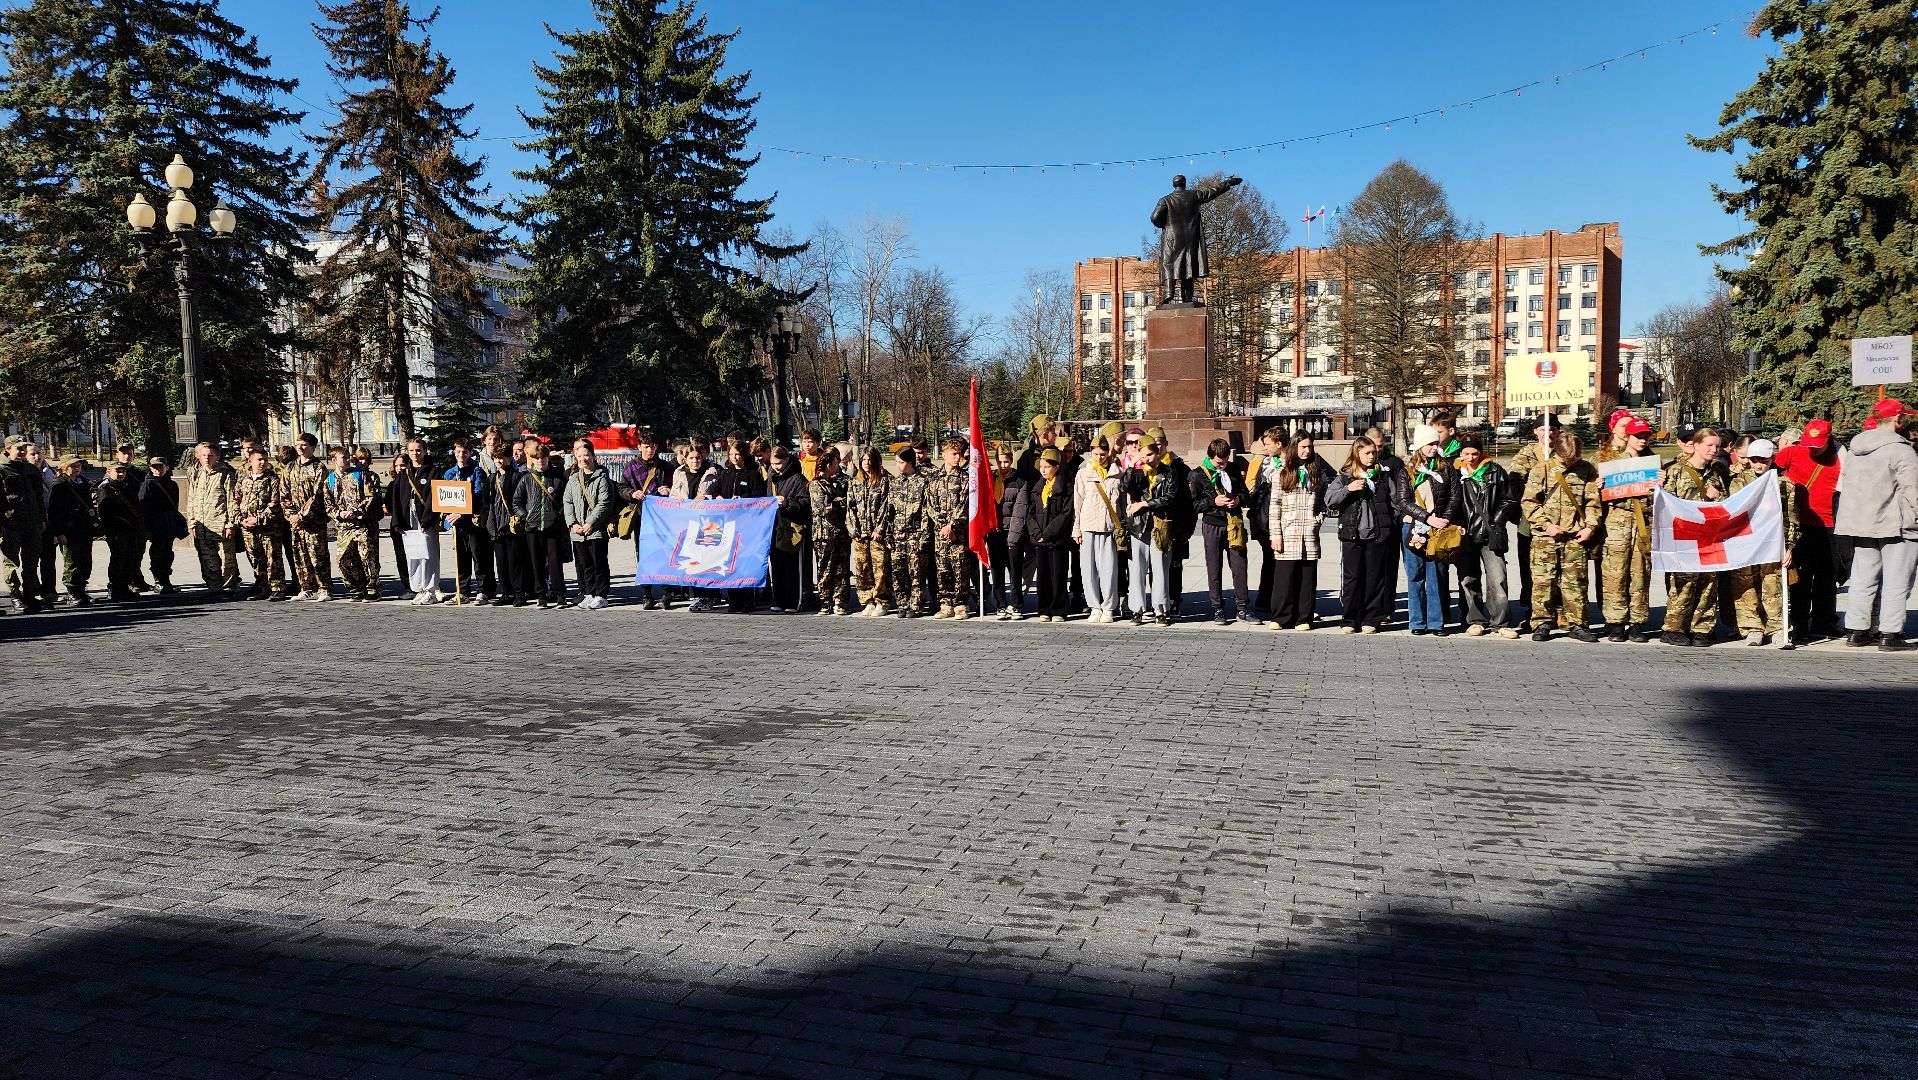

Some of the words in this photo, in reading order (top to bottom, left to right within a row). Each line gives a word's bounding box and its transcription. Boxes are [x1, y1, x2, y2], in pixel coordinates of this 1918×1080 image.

[1871, 342, 1893, 350] МБОУ
[1510, 391, 1560, 402] ШКОЛА
[1565, 389, 1584, 400] №2
